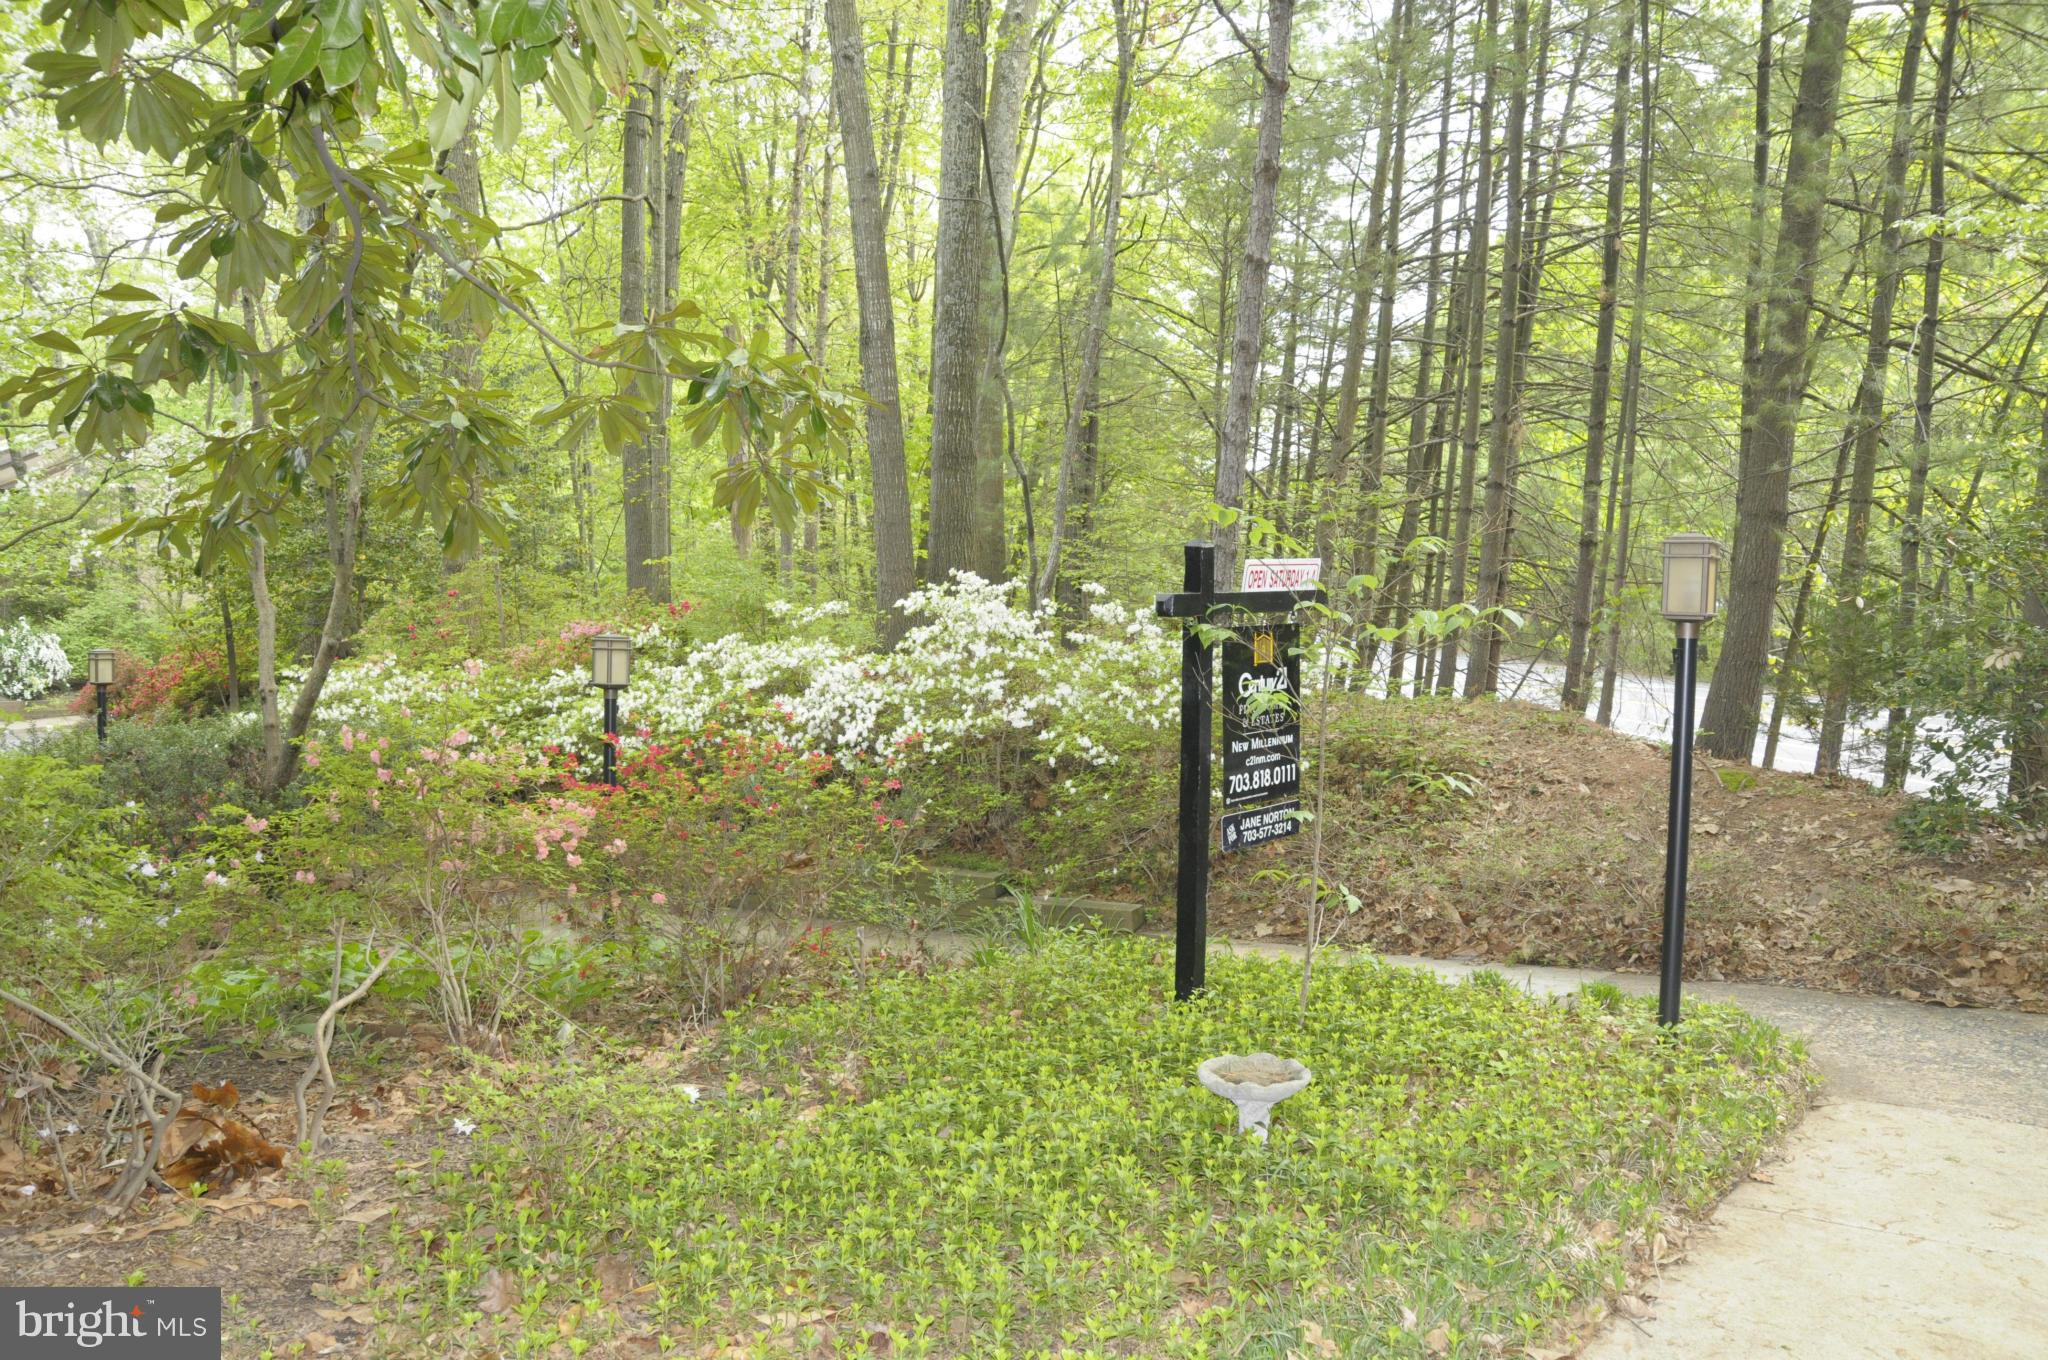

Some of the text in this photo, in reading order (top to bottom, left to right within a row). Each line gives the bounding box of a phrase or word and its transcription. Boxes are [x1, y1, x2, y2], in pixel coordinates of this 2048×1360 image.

[1247, 570, 1267, 588] OPEN
[1269, 569, 1304, 587] SATURDAY
[1229, 764, 1296, 794] 703.818.0111
[1240, 815, 1262, 831] JANE
[1242, 820, 1292, 843] 703-577-3214
